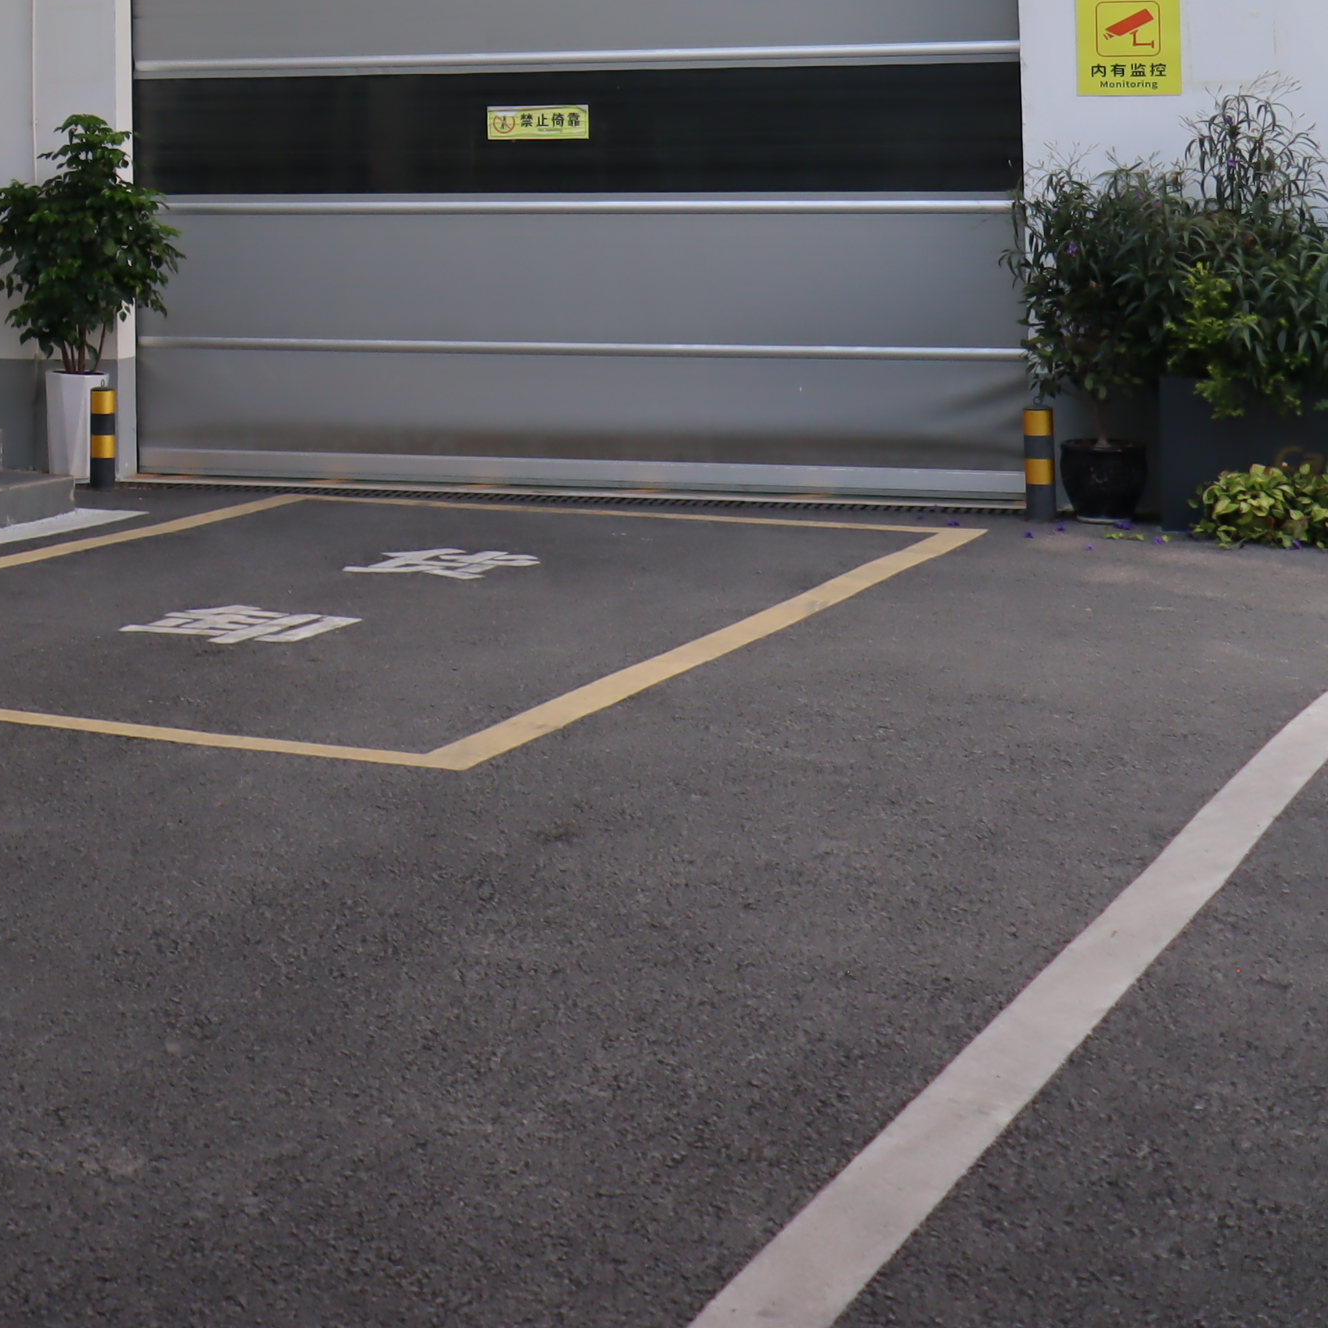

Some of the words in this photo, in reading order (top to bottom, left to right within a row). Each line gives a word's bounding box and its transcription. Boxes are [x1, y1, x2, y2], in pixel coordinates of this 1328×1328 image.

[1091, 62, 1167, 78] 内有监控
[1100, 80, 1158, 90] Monitoring
[520, 112, 581, 128] 禁止倚靠
